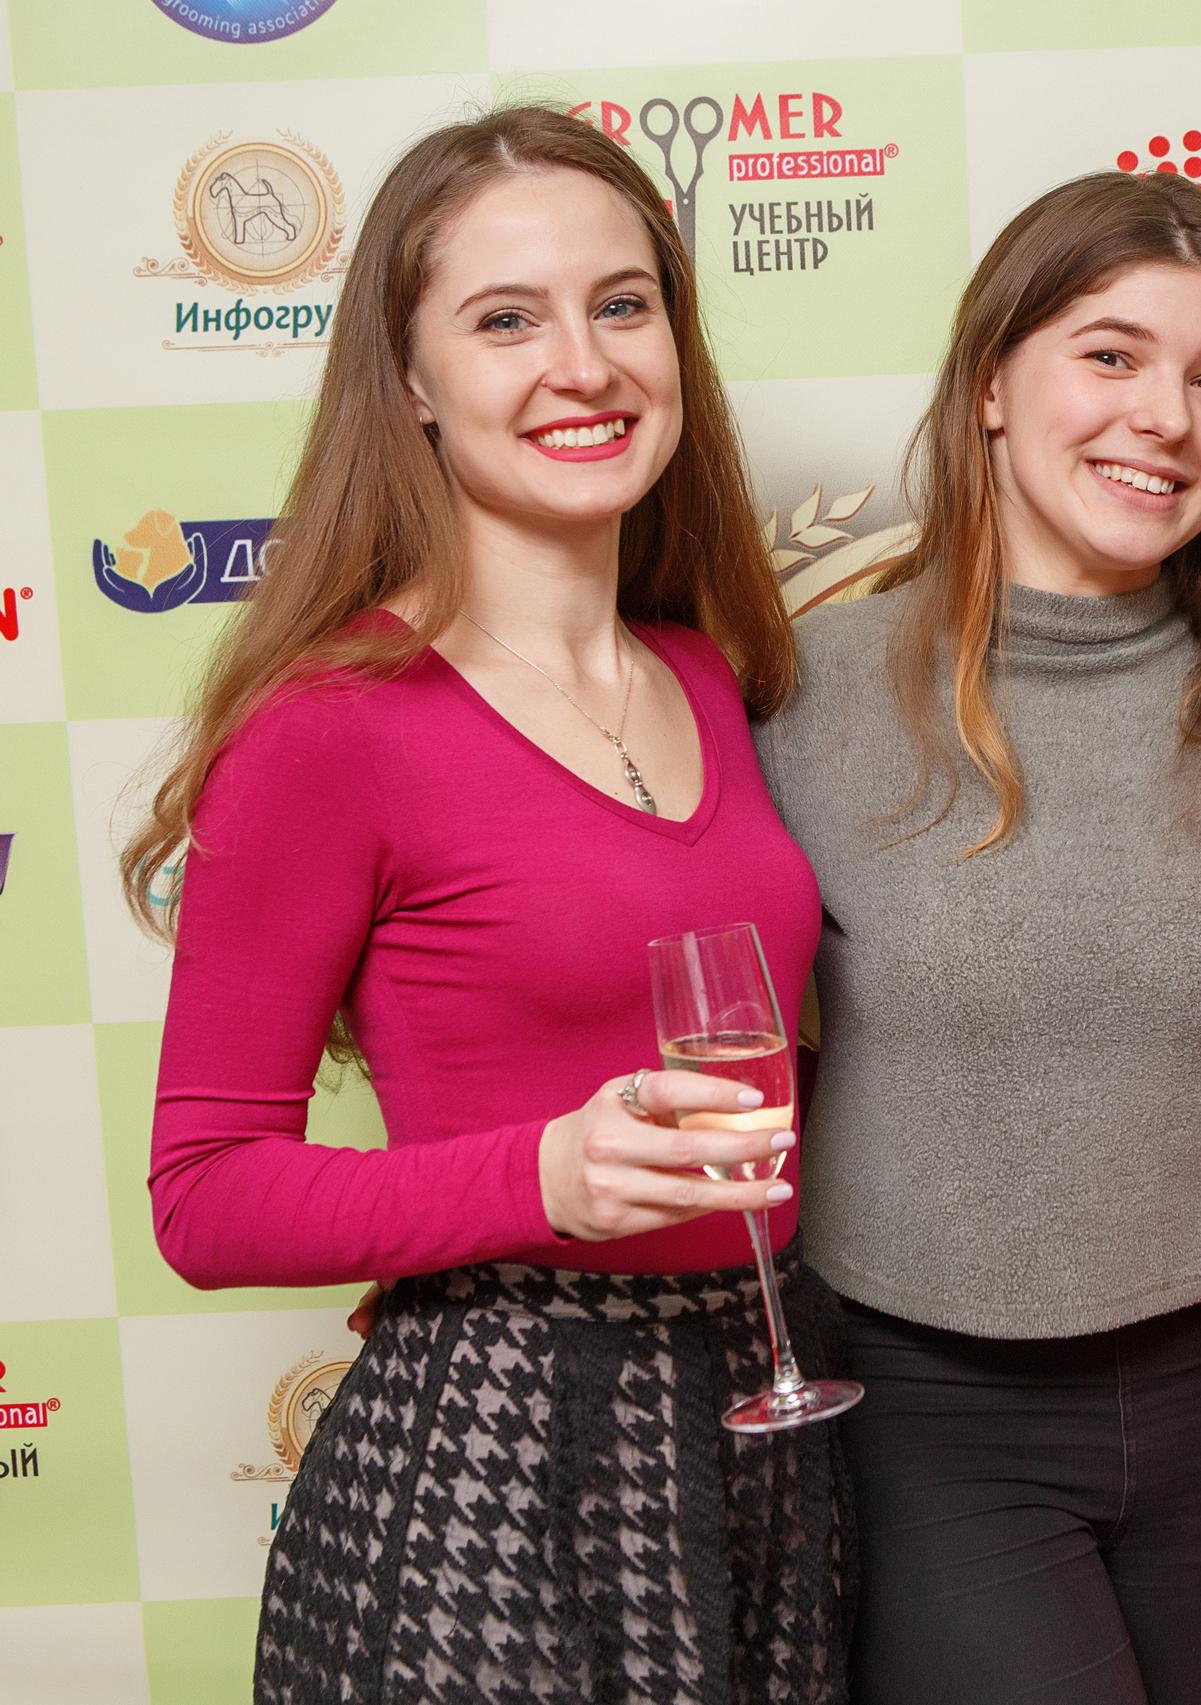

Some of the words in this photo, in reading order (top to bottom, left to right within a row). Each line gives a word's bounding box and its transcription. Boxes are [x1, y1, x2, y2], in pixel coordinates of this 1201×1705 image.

[732, 149, 881, 182] professional
[728, 192, 874, 236] УЧЕБНЫЙ
[732, 237, 829, 276] ЦЕНТР
